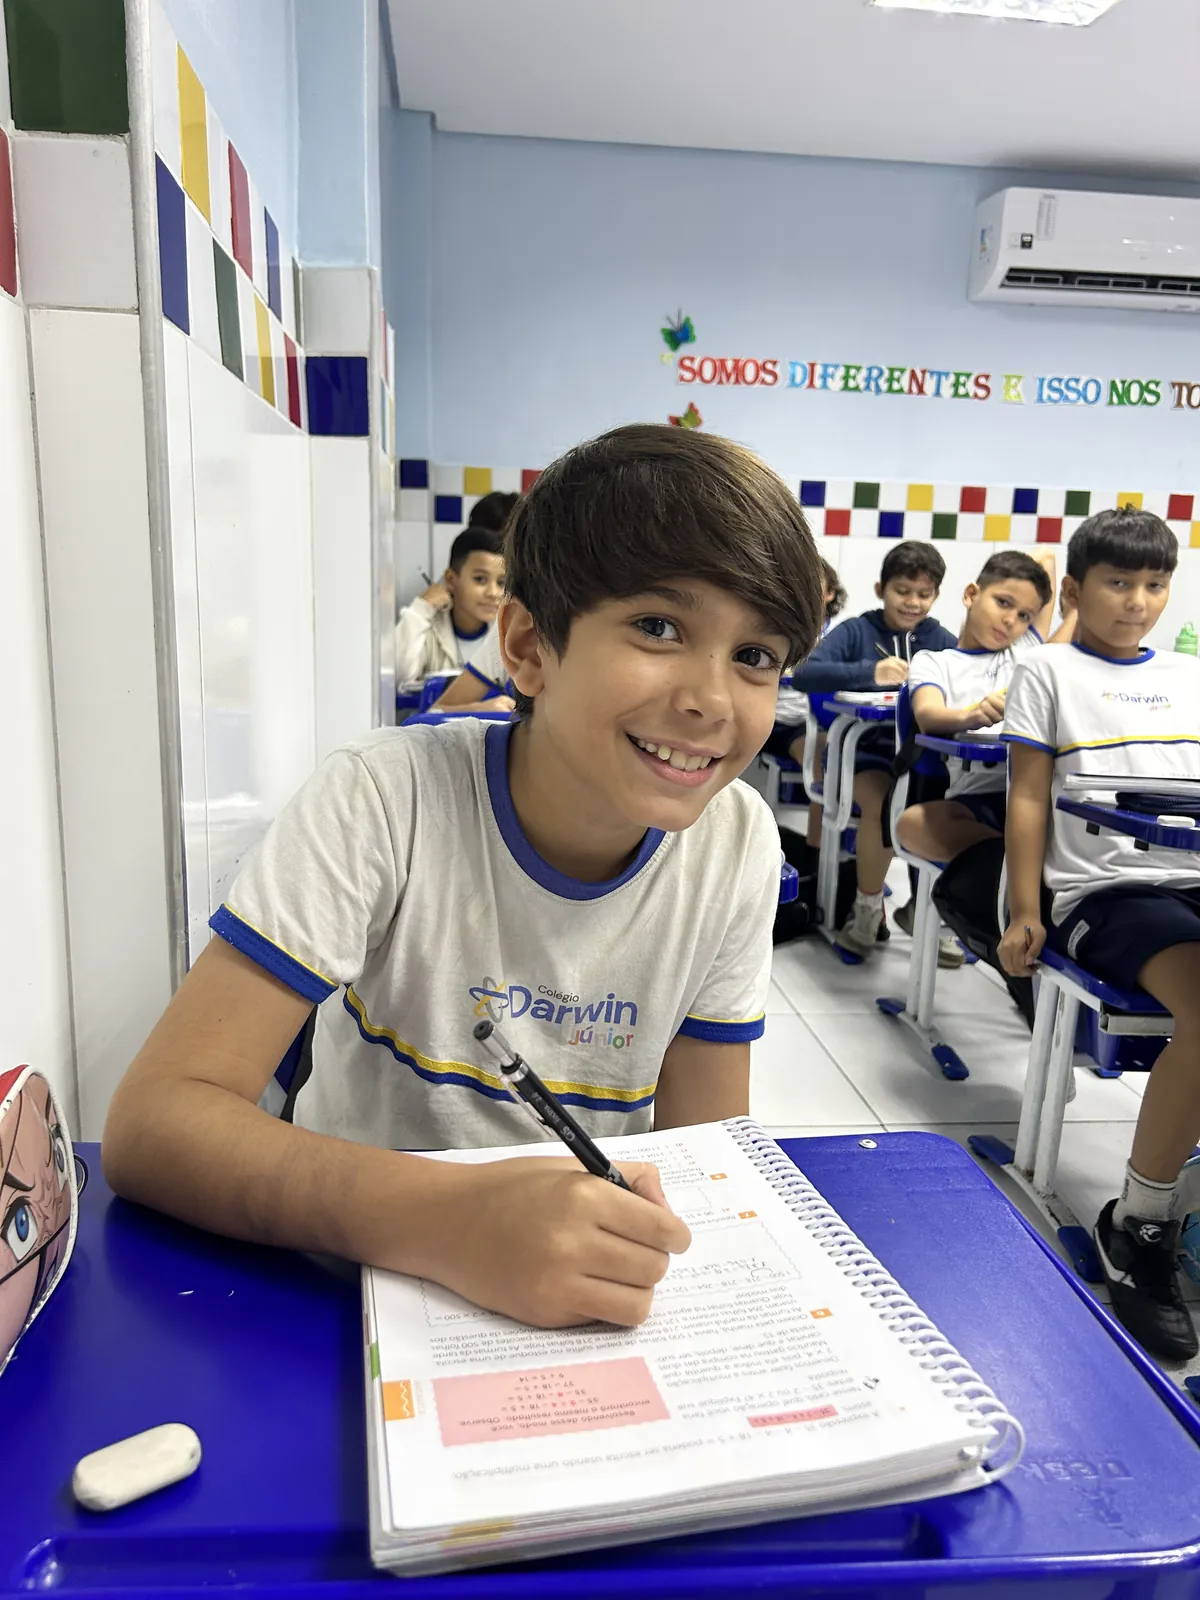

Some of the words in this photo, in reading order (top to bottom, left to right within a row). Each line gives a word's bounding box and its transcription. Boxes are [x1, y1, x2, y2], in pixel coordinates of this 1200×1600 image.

[677, 355, 779, 386] SOMOS
[788, 360, 992, 400] DIFERENTES
[1001, 373, 1024, 403] E
[1036, 376, 1102, 405] ISSO
[1106, 378, 1162, 407] NOS
[1118, 692, 1169, 704] Darwin
[508, 985, 639, 1026] Darwin
[537, 984, 580, 1004] Colégio
[567, 1025, 635, 1049] júnior
